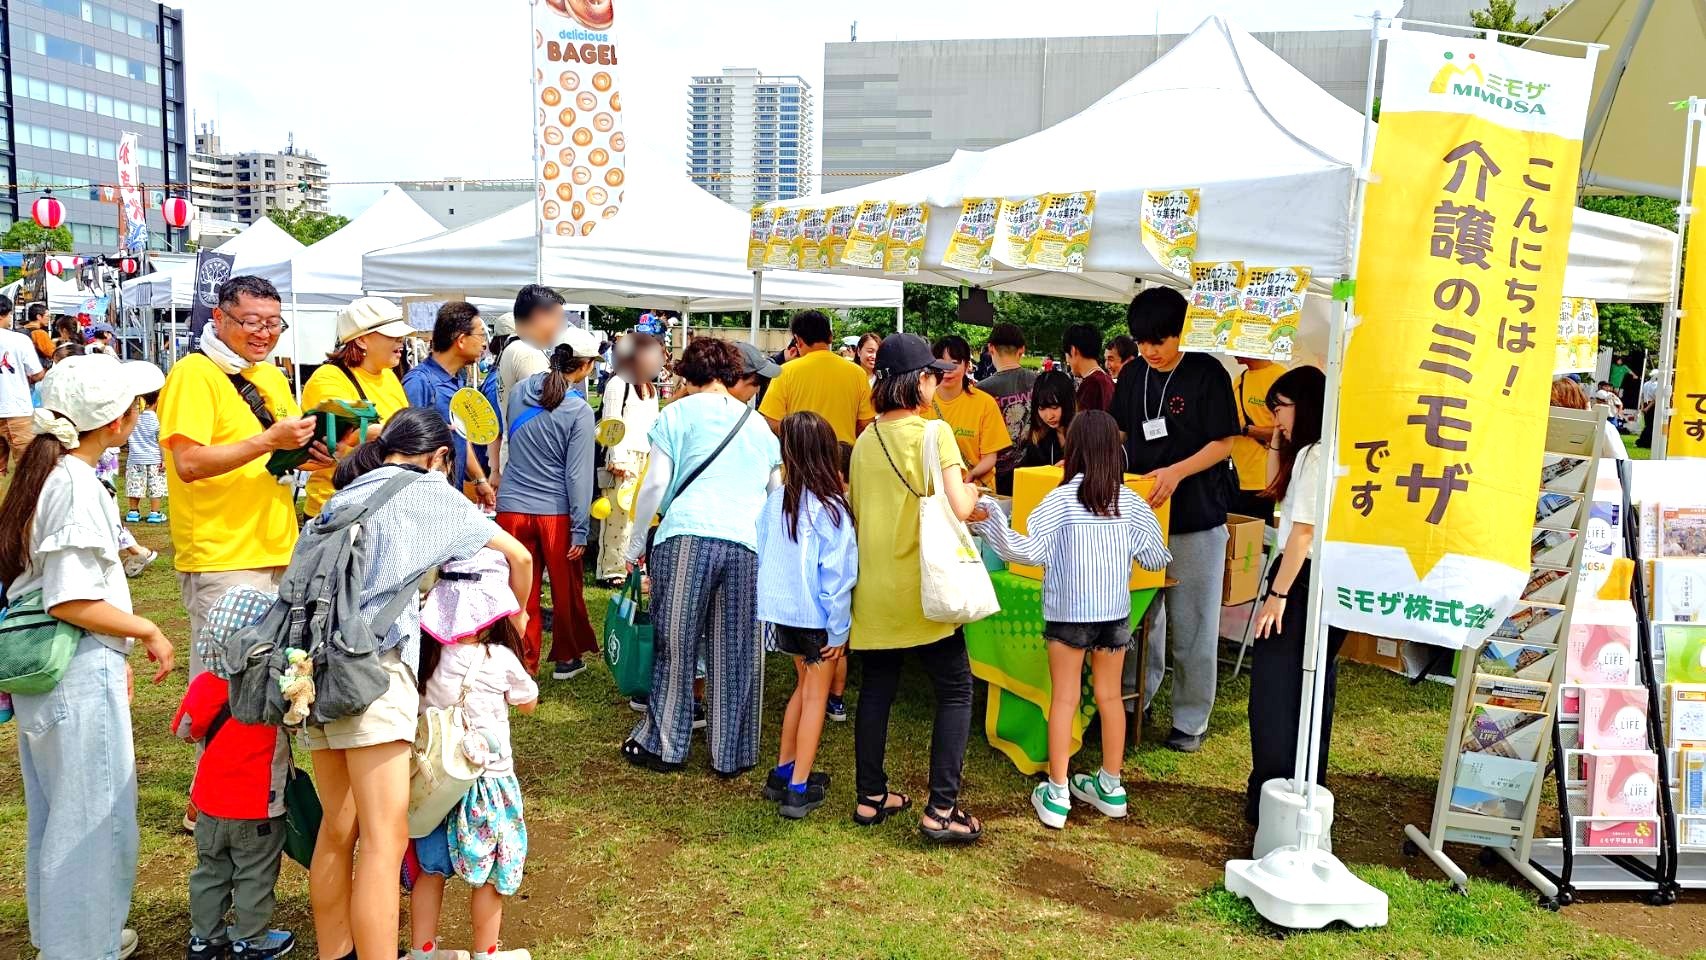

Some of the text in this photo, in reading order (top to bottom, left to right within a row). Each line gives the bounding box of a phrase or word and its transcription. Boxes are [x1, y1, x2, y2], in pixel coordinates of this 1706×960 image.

[558, 28, 609, 42] delicious
[547, 40, 618, 65] BAGEL
[1486, 73, 1551, 99] ミモザ
[1453, 83, 1546, 115] MIMOSA
[1396, 140, 1501, 525] 介護のミモザ
[1351, 440, 1391, 518] です
[1580, 562, 1606, 571] MOSA
[1604, 655, 1624, 665] LIFE
[1620, 720, 1640, 730] LIFE
[1629, 787, 1648, 796] LIFE
